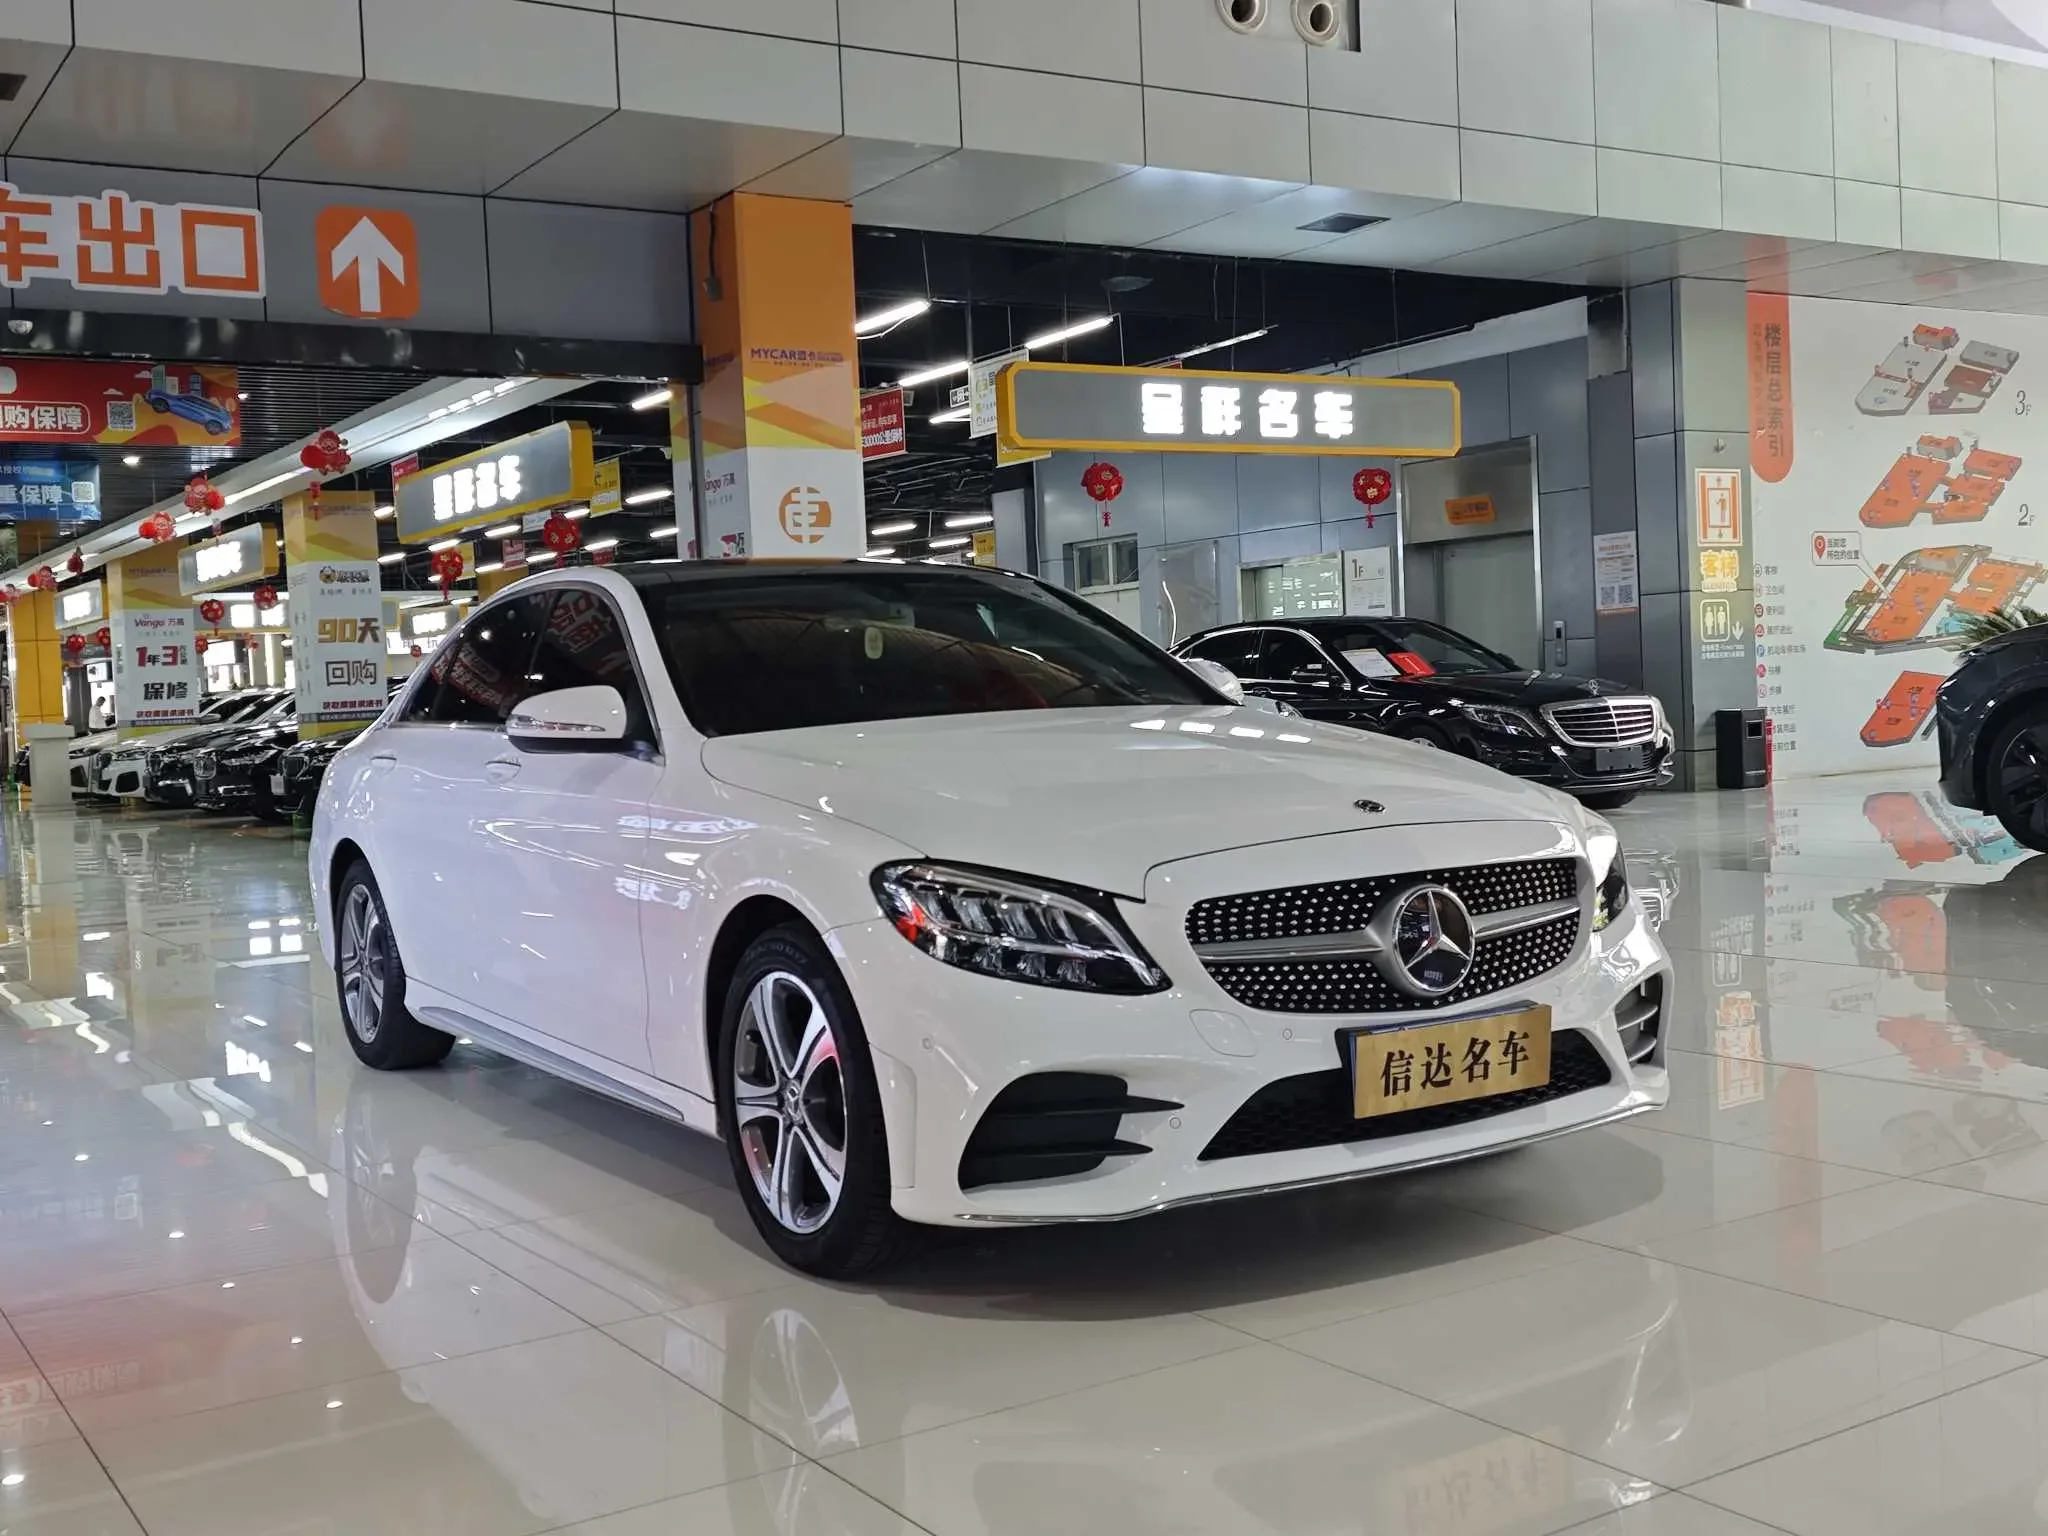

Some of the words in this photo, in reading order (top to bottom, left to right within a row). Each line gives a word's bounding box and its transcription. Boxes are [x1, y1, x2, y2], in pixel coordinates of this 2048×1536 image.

[1764, 322, 1784, 457] 楼层总索引
[0, 405, 83, 431] 购保障
[2017, 503, 2036, 527] 2F
[317, 617, 380, 644] 90天
[325, 659, 377, 686] 回购
[143, 681, 188, 701] 保修
[1380, 1030, 1530, 1098] 信达名车
